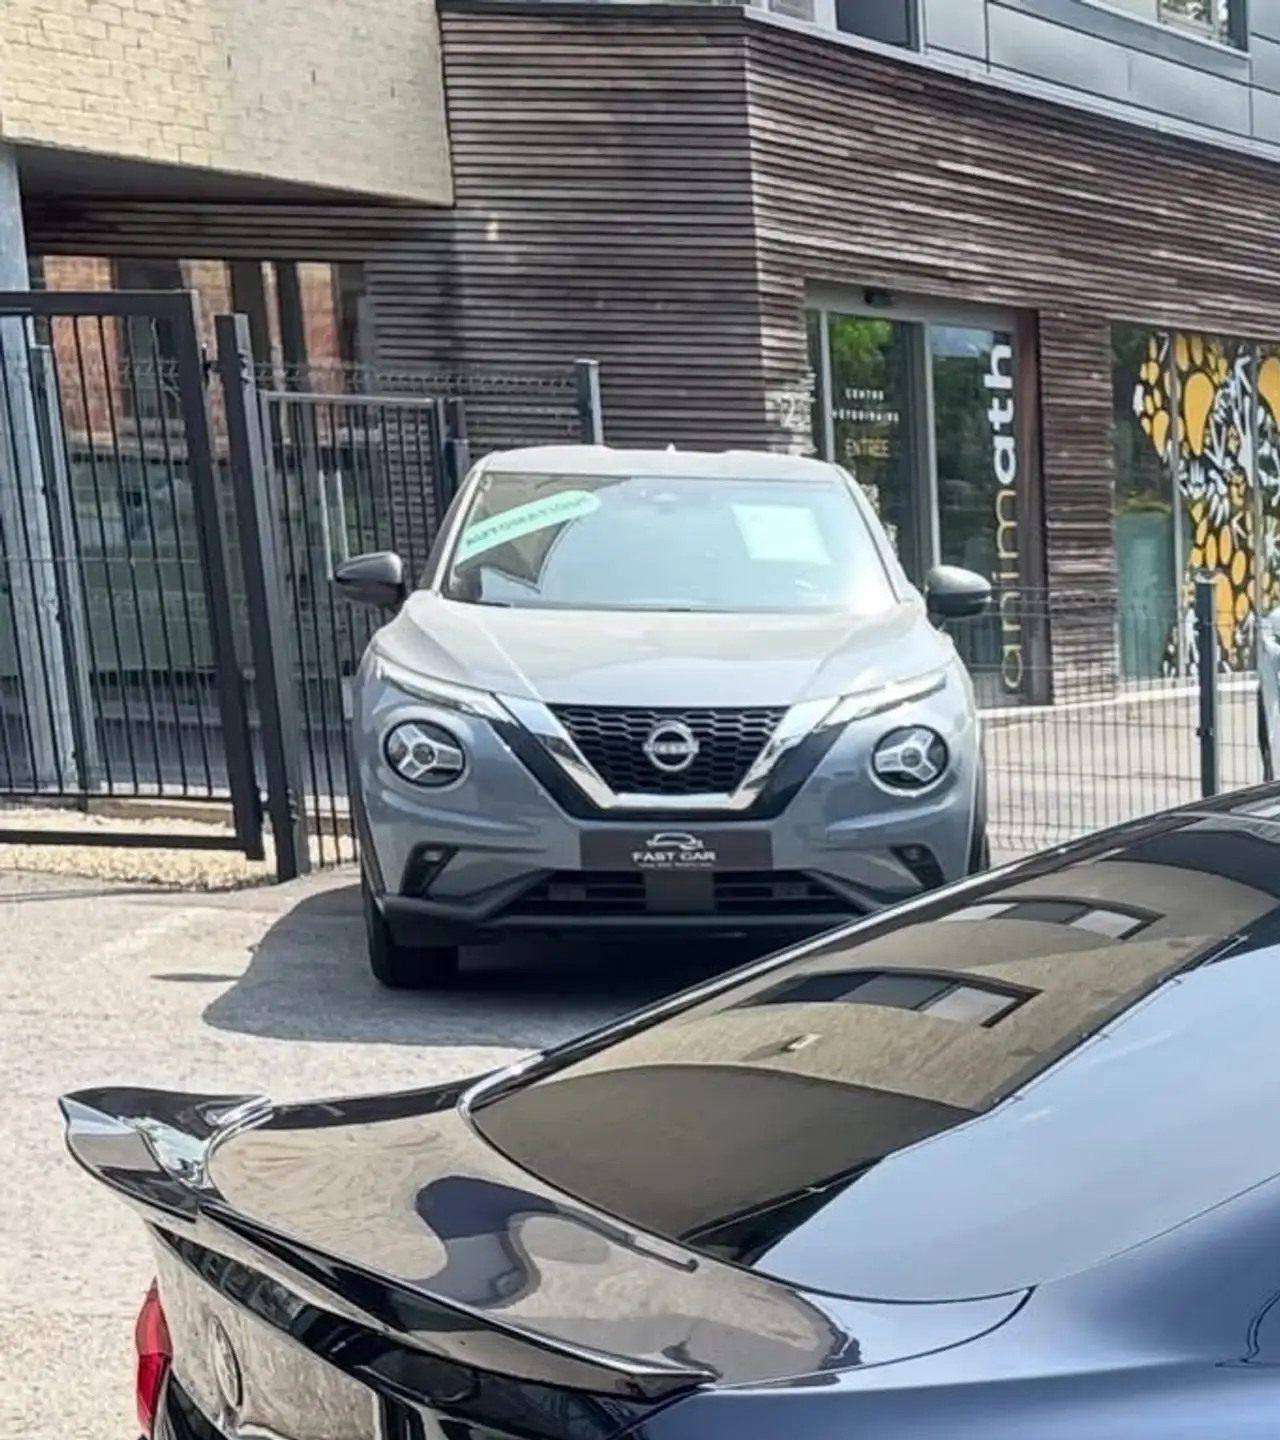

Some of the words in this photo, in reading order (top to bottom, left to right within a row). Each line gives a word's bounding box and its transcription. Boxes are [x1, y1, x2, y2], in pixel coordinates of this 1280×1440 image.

[984, 344, 1023, 689] animath
[632, 852, 675, 862] FAST
[680, 852, 716, 862] CAR
